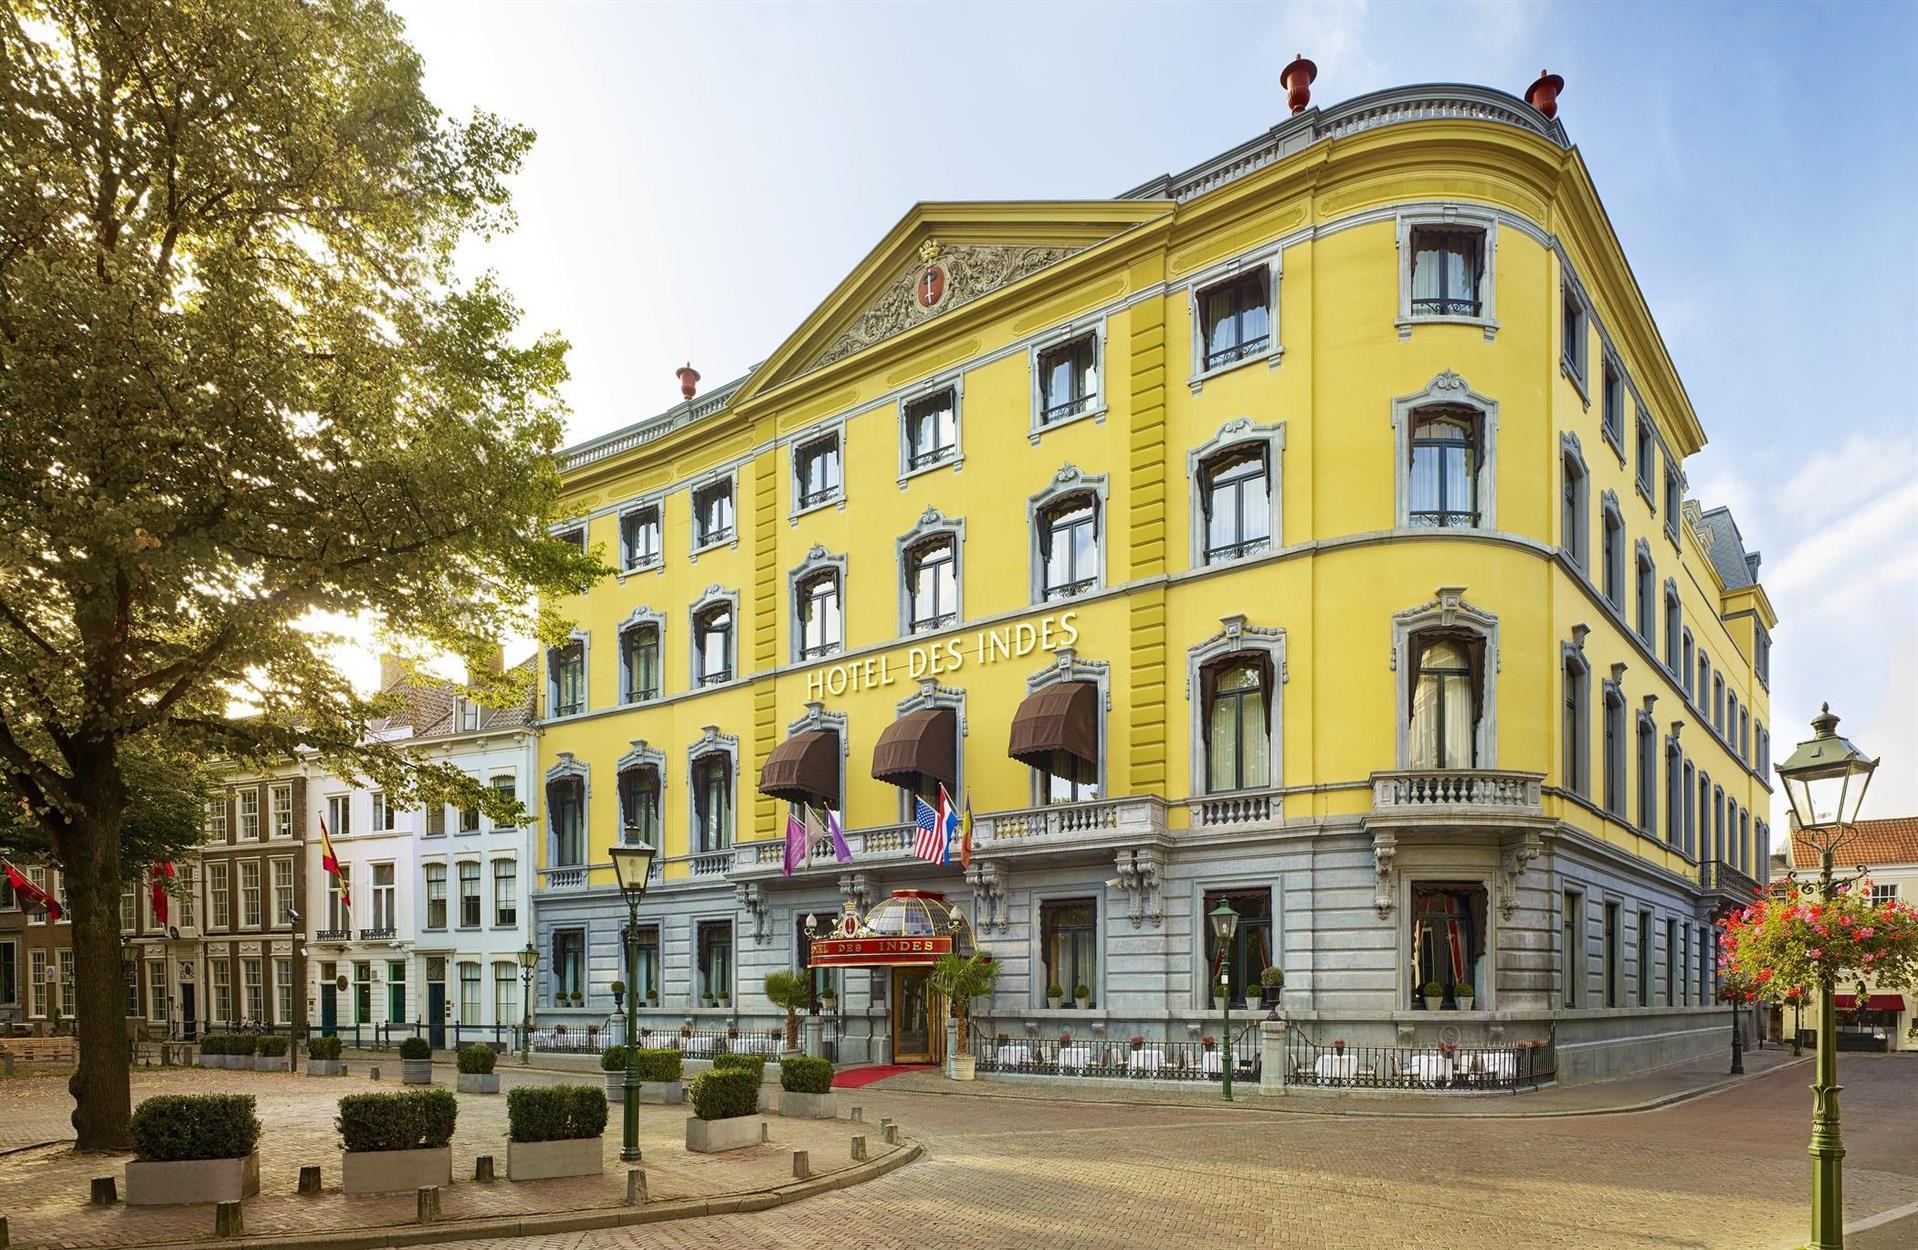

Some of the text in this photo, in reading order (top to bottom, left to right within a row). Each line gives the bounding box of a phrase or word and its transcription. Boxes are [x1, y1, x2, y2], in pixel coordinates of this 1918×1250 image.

[807, 611, 1079, 699] HOTEL DES INDES
[838, 943, 862, 953] DES
[878, 941, 934, 951] INDES
